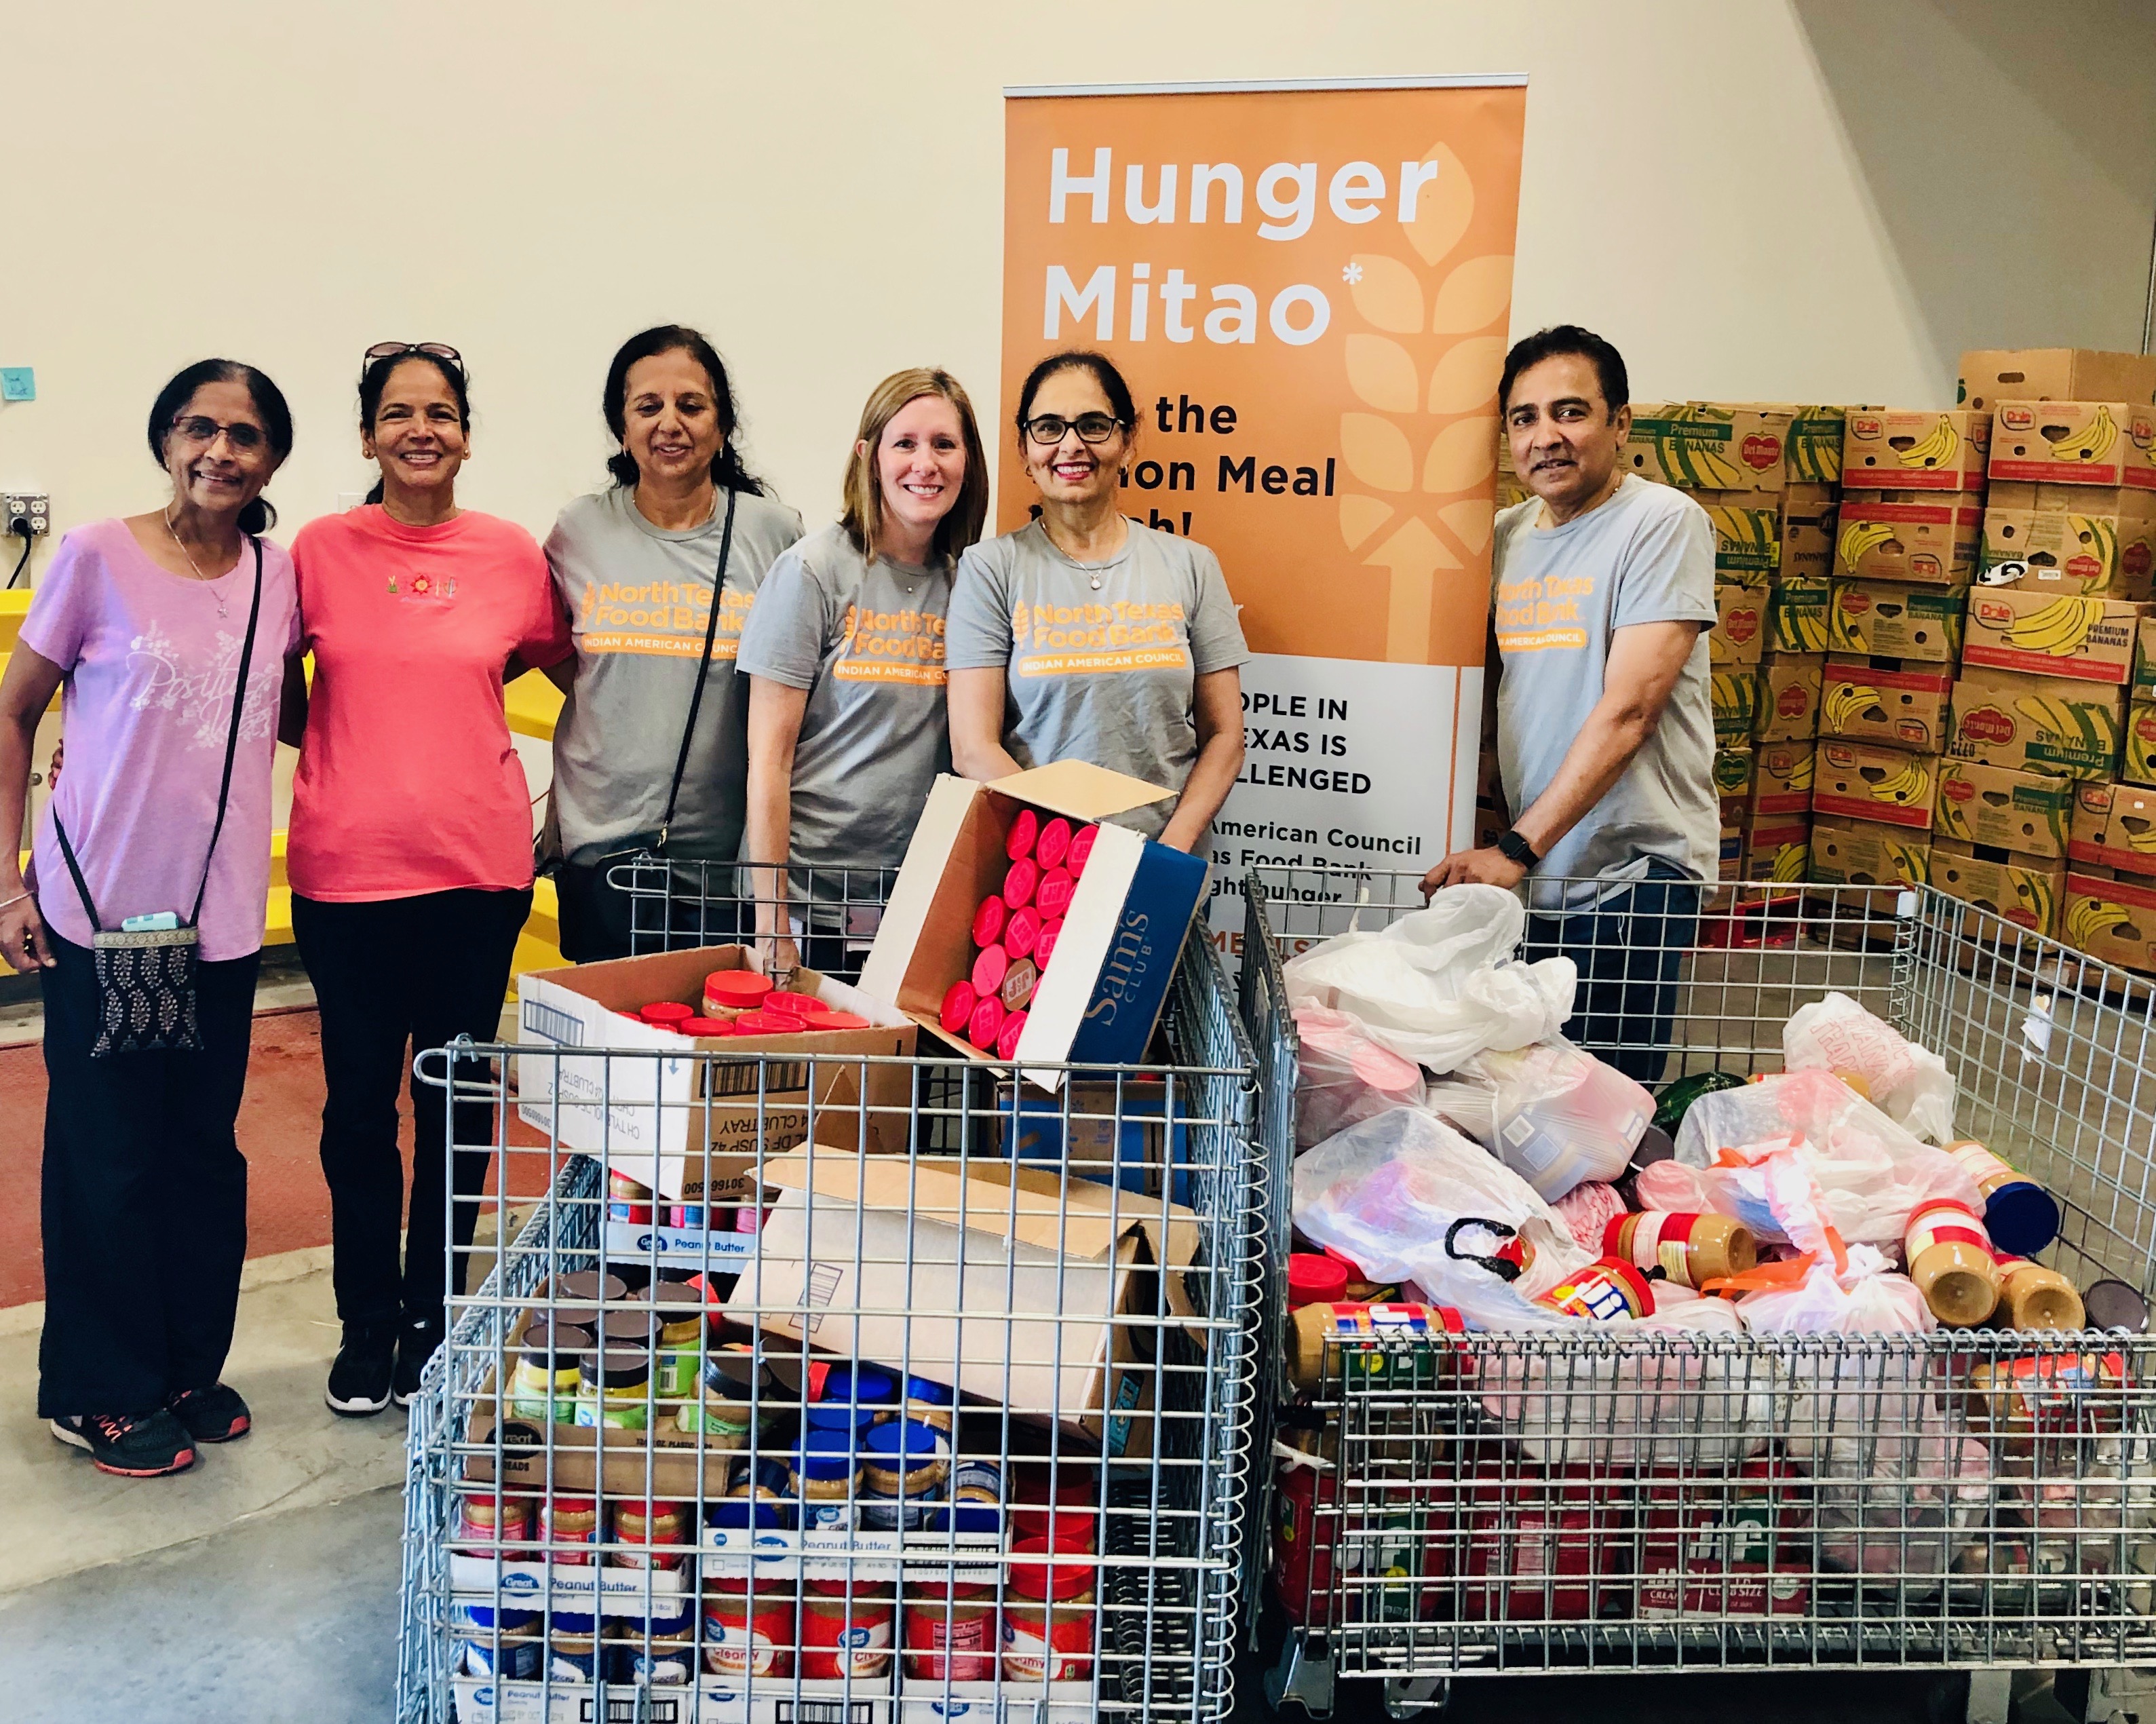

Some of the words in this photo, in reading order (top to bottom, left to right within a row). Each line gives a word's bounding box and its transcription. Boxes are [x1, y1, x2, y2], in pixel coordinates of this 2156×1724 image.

[1049, 147, 1438, 241] Hunger
[1156, 395, 1237, 434] the
[1670, 423, 1718, 438] Premium
[1857, 421, 1879, 429] Dole
[1668, 439, 1725, 454] BNANAS
[1218, 455, 1335, 497] Meal
[1720, 540, 1771, 554] BNANAS
[1727, 555, 1769, 569] Premium
[599, 580, 679, 603] North
[596, 606, 670, 627] Food
[1033, 603, 1113, 626] North
[1111, 600, 1185, 621] Texas
[1497, 602, 1534, 628] ood
[1980, 604, 2010, 618] Dole
[862, 609, 922, 634] North
[2087, 624, 2130, 636] PREMIUM
[1033, 626, 1106, 649] Food
[1108, 620, 1178, 646] Bank
[2086, 634, 2128, 647] BANANAS
[584, 637, 621, 647] INDIAN
[625, 638, 691, 651] AMERICAN
[695, 643, 737, 654] CUNC
[855, 632, 915, 658] Food
[1022, 659, 1063, 672] INDIAN
[1066, 654, 1132, 668] AMERICAN
[1135, 653, 1183, 664] COUNCIL
[838, 666, 880, 676] INDIAN
[884, 667, 931, 680] AMERICAN
[1317, 698, 1348, 721] IN
[1321, 734, 1347, 756] IS
[2035, 730, 2106, 751] BNANAS
[2043, 748, 2104, 767] Premium
[1327, 828, 1421, 855] Council
[1085, 910, 1149, 1026] Sam's
[1125, 945, 1152, 1003] CLUB
[558, 1069, 594, 1094] CLUBTRA
[773, 1134, 791, 1151] DF
[714, 1242, 746, 1253] Butter
[494, 1433, 533, 1445] reat
[491, 1461, 530, 1472] SREADS
[1650, 1590, 1689, 1601] CREAY
